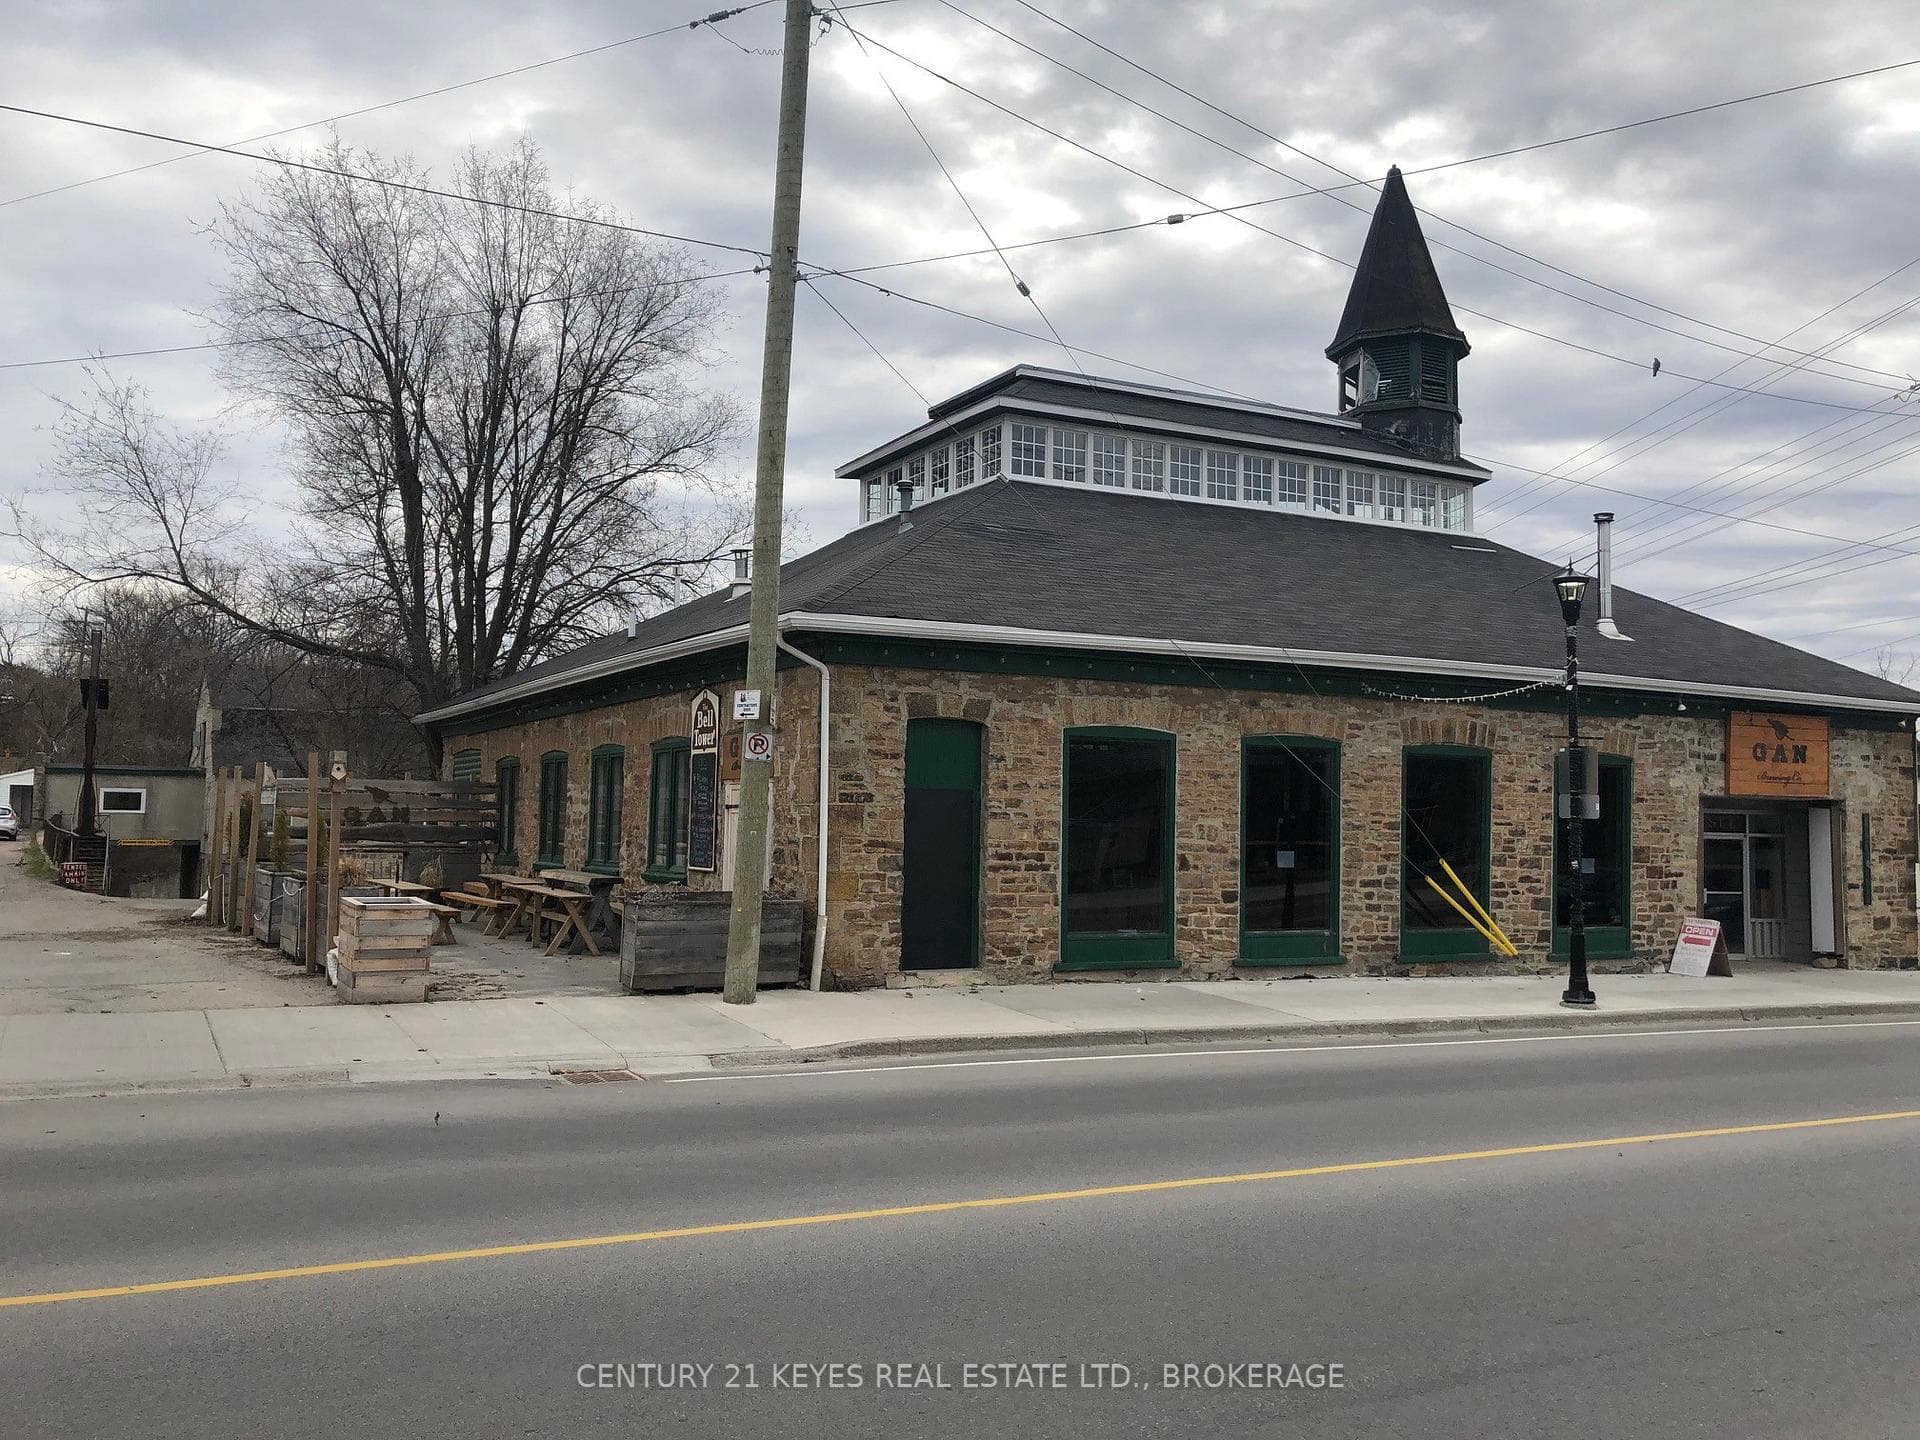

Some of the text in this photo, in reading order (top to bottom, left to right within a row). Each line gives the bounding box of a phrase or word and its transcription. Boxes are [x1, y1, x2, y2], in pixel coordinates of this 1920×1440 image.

[697, 710, 713, 728] Bell
[694, 730, 715, 747] Tower
[1752, 742, 1808, 763] GAN
[1686, 926, 1714, 936] OPEN
